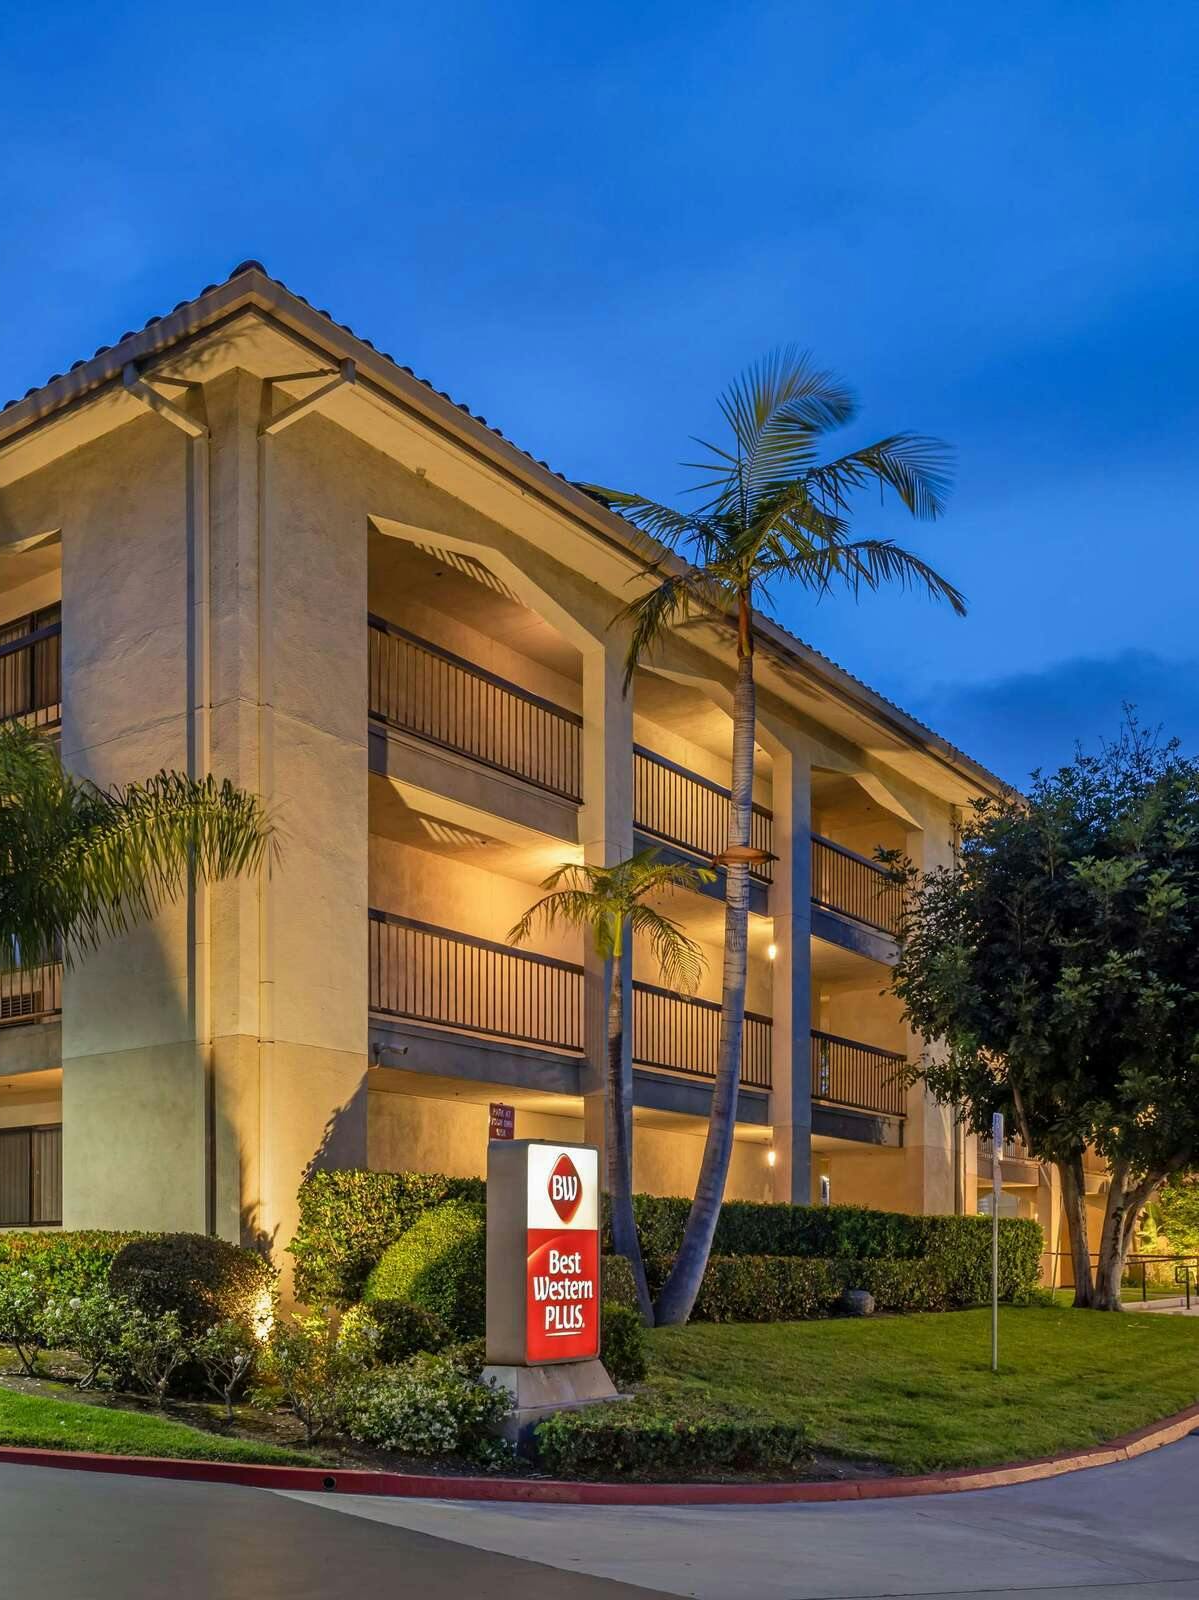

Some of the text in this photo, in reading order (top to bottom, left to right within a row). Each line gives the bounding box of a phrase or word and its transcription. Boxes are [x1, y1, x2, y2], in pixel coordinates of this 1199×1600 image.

[553, 1175, 577, 1201] BW
[549, 1249, 582, 1274] Best
[533, 1276, 593, 1301] Western
